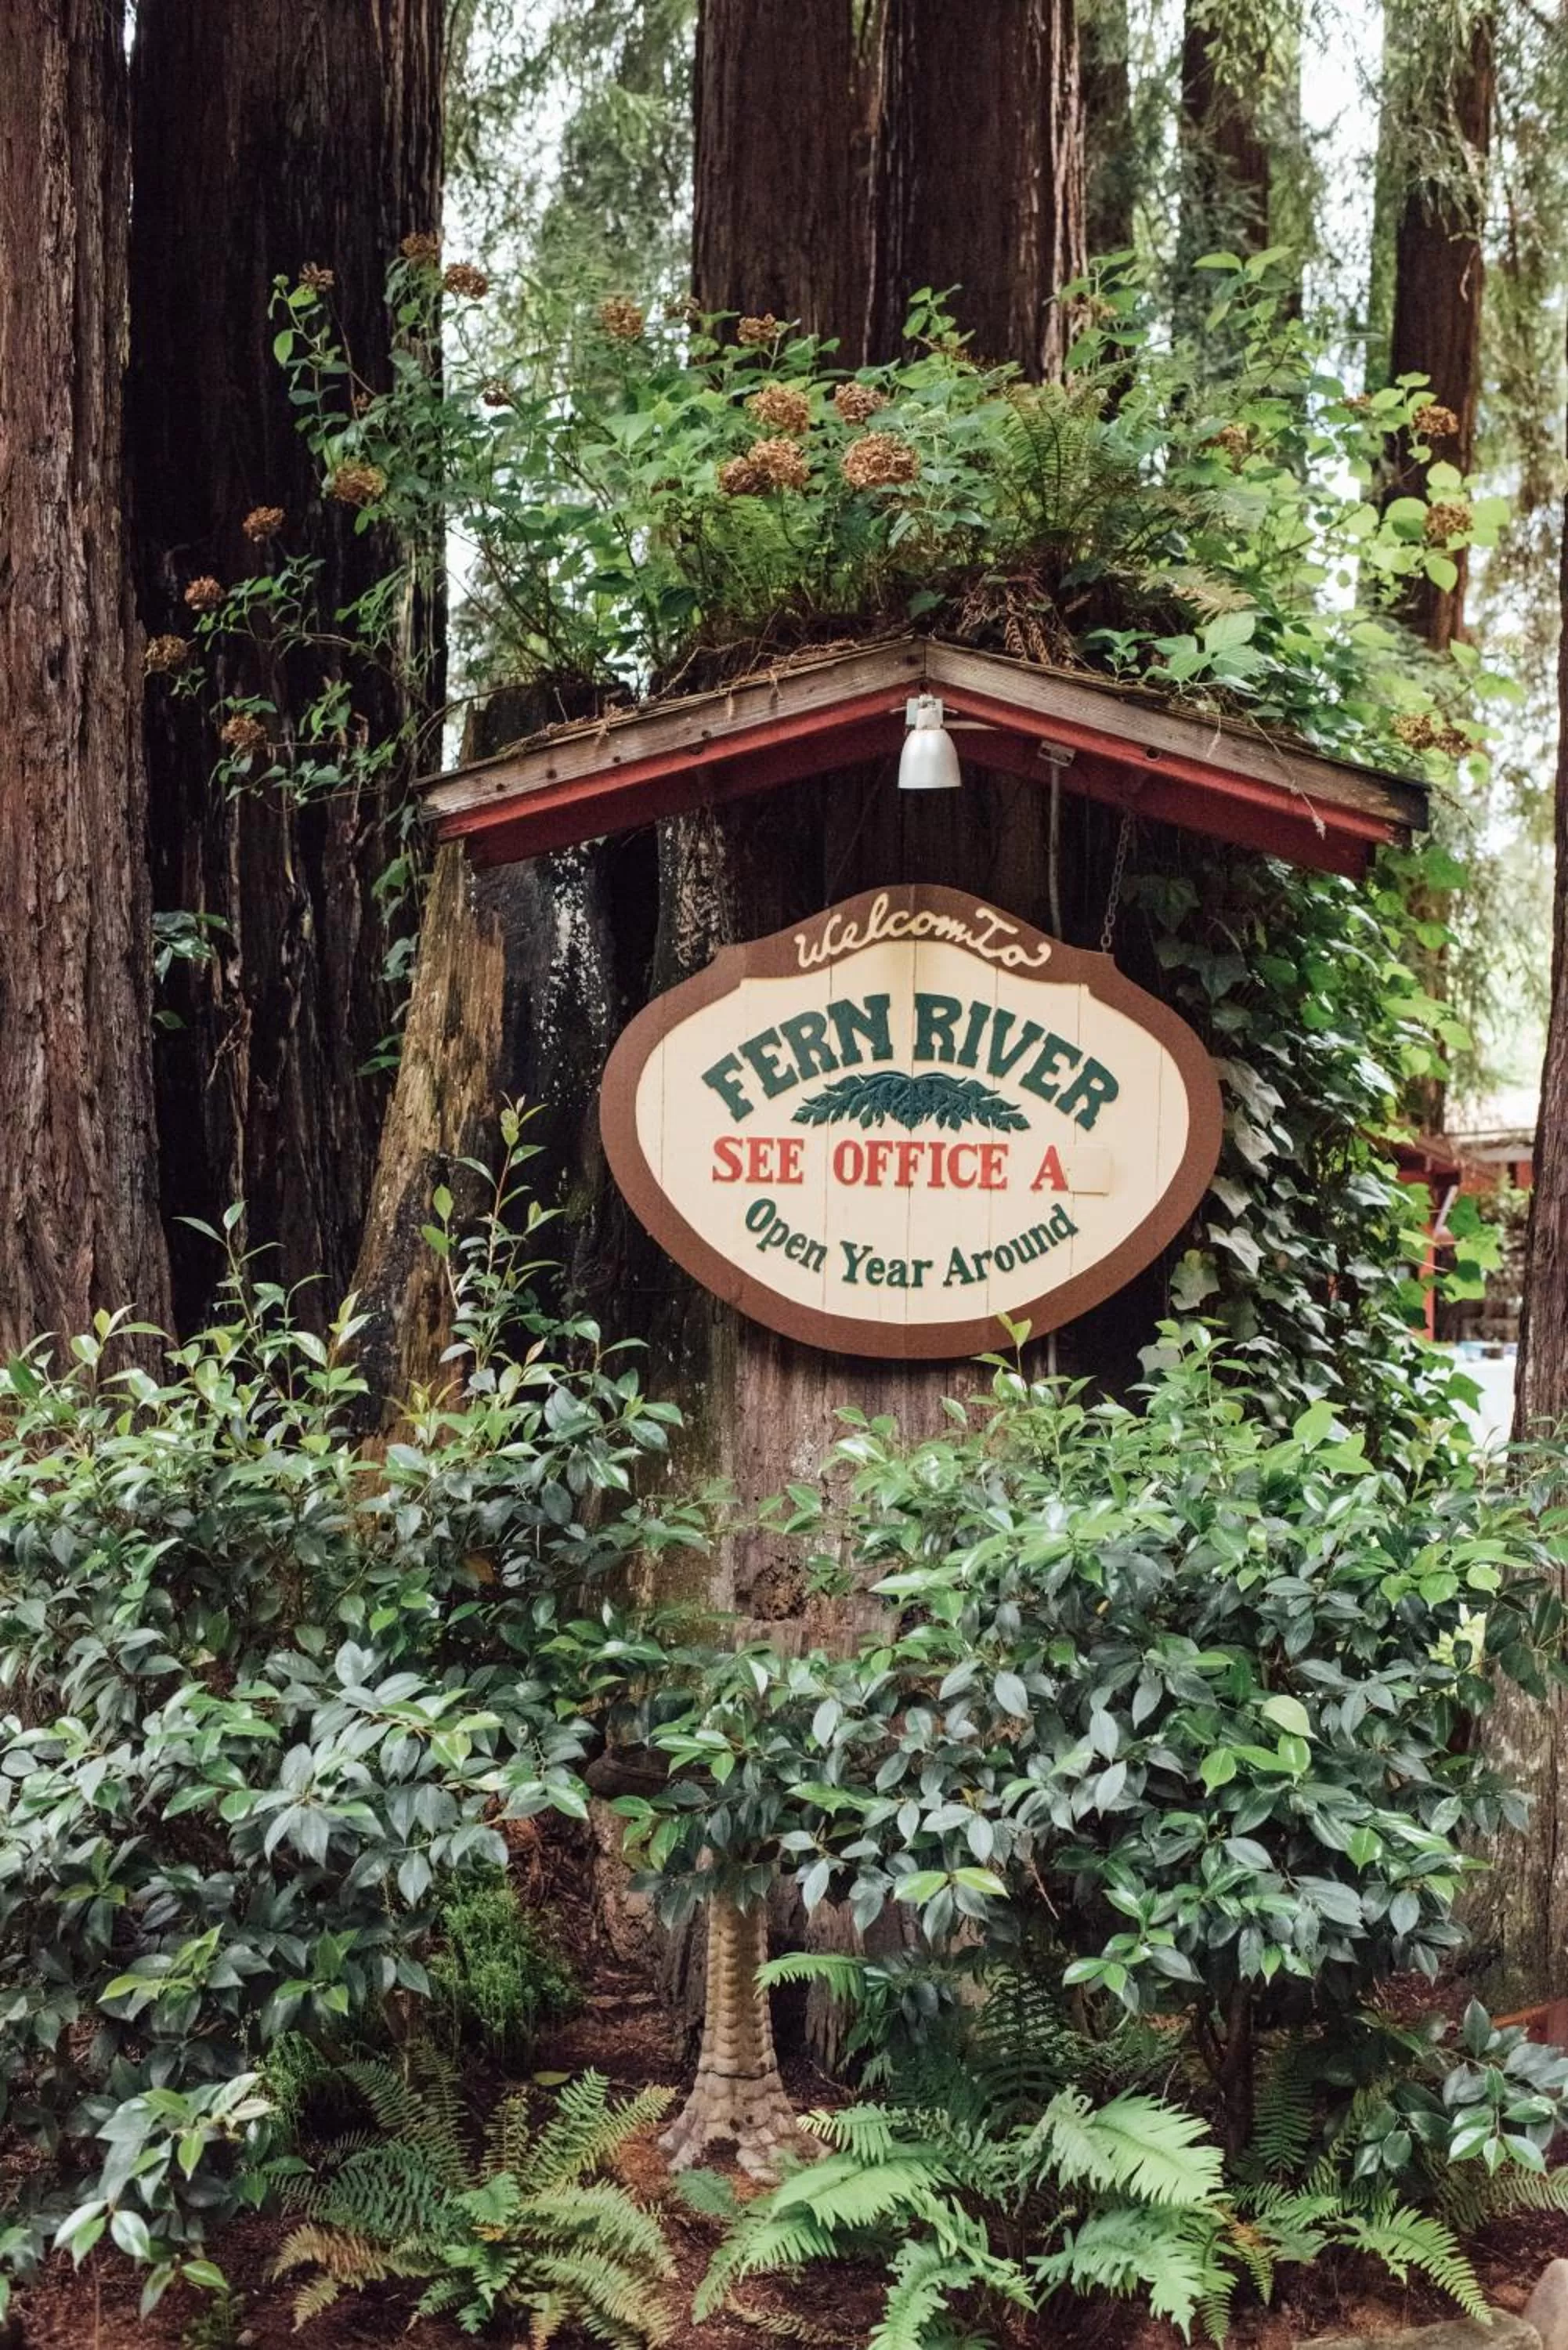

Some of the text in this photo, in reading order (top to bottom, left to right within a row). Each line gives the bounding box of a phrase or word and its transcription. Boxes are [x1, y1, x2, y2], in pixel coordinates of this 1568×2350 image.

[702, 992, 1120, 1131] FERN RIVER
[711, 1136, 805, 1184] SEE
[833, 1141, 1009, 1189] OFFICE
[745, 1198, 1079, 1289] Open Year Around
